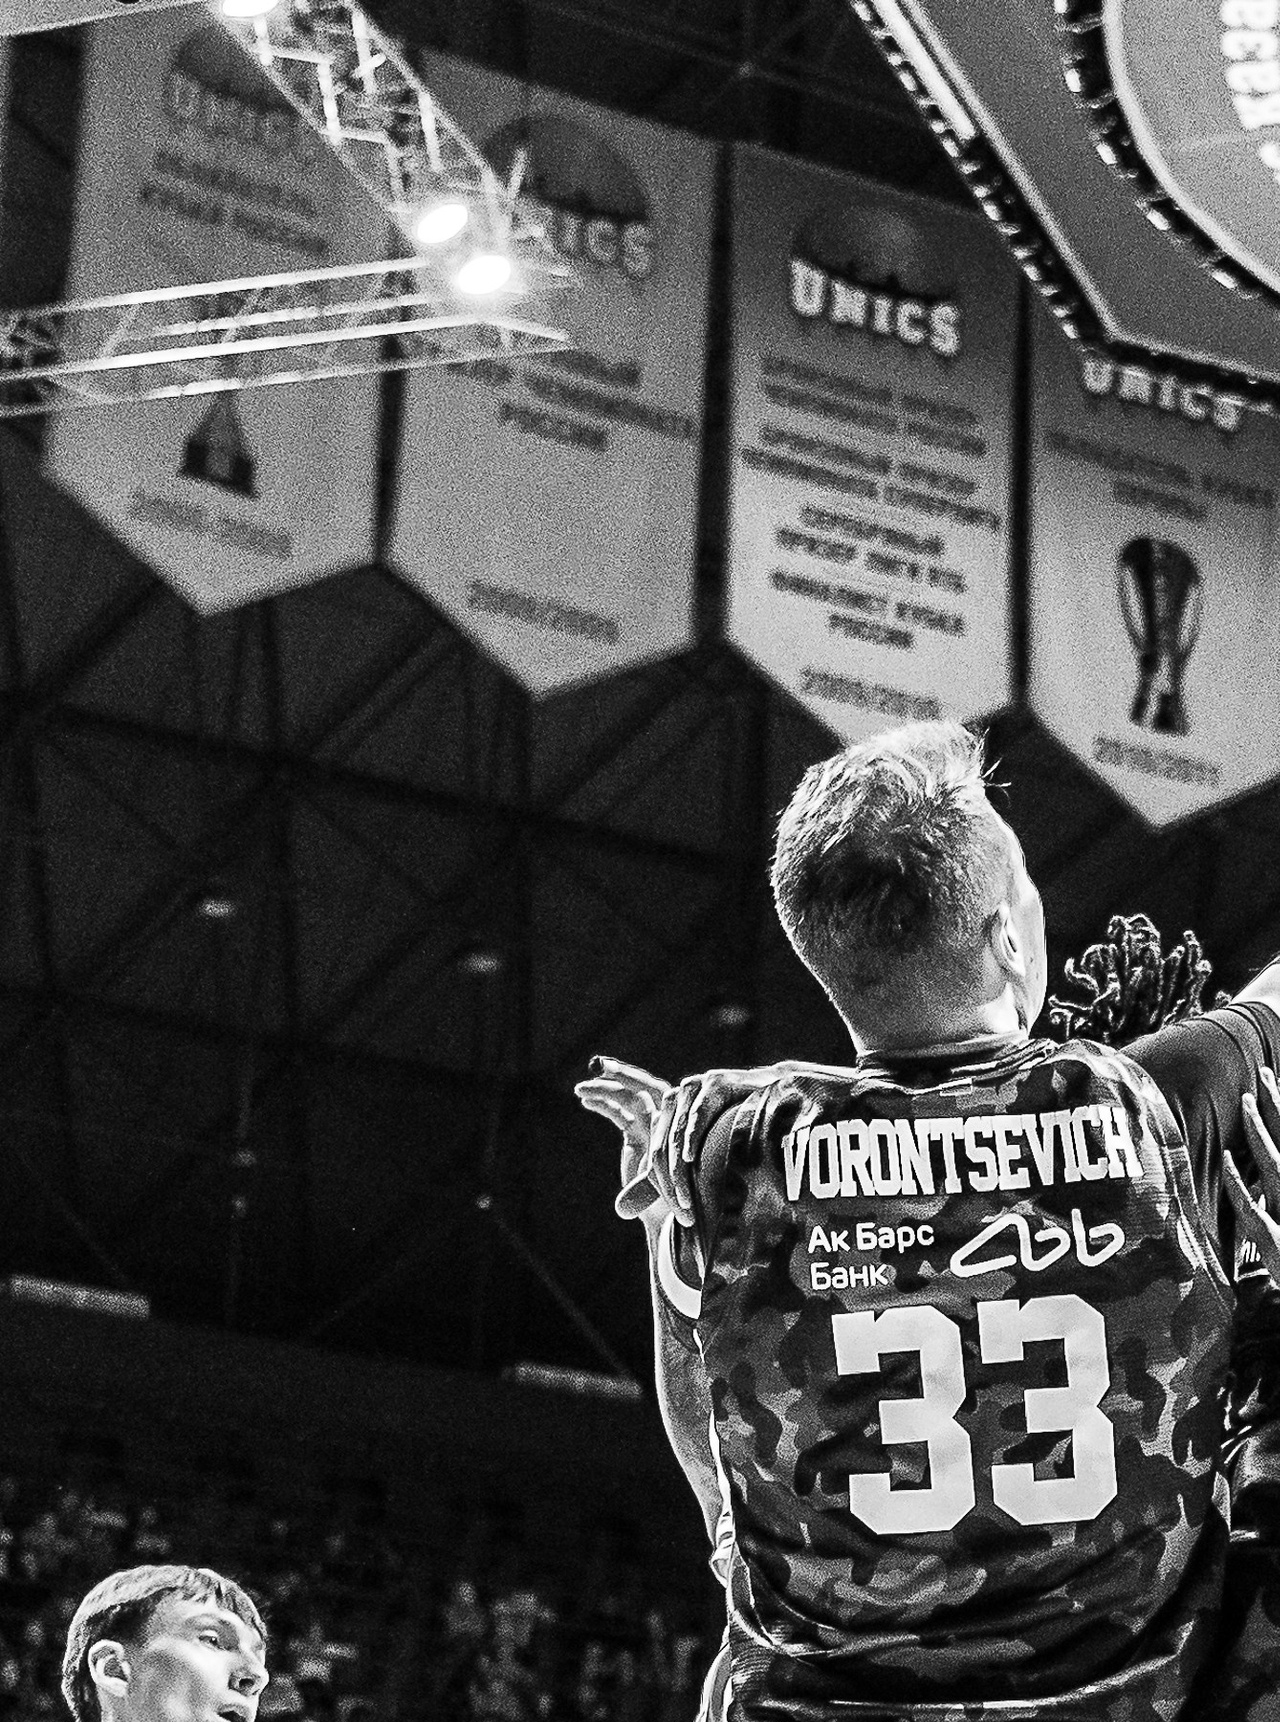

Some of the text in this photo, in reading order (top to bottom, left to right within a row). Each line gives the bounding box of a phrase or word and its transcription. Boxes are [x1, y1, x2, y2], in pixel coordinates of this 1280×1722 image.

[791, 260, 959, 354] UNICS
[1083, 360, 1242, 432] UNICS
[782, 1103, 1144, 1201] VORONTSEVICH
[807, 1222, 935, 1254] Ак Барс
[810, 1262, 889, 1291] Банк
[831, 1294, 1118, 1536] 33
